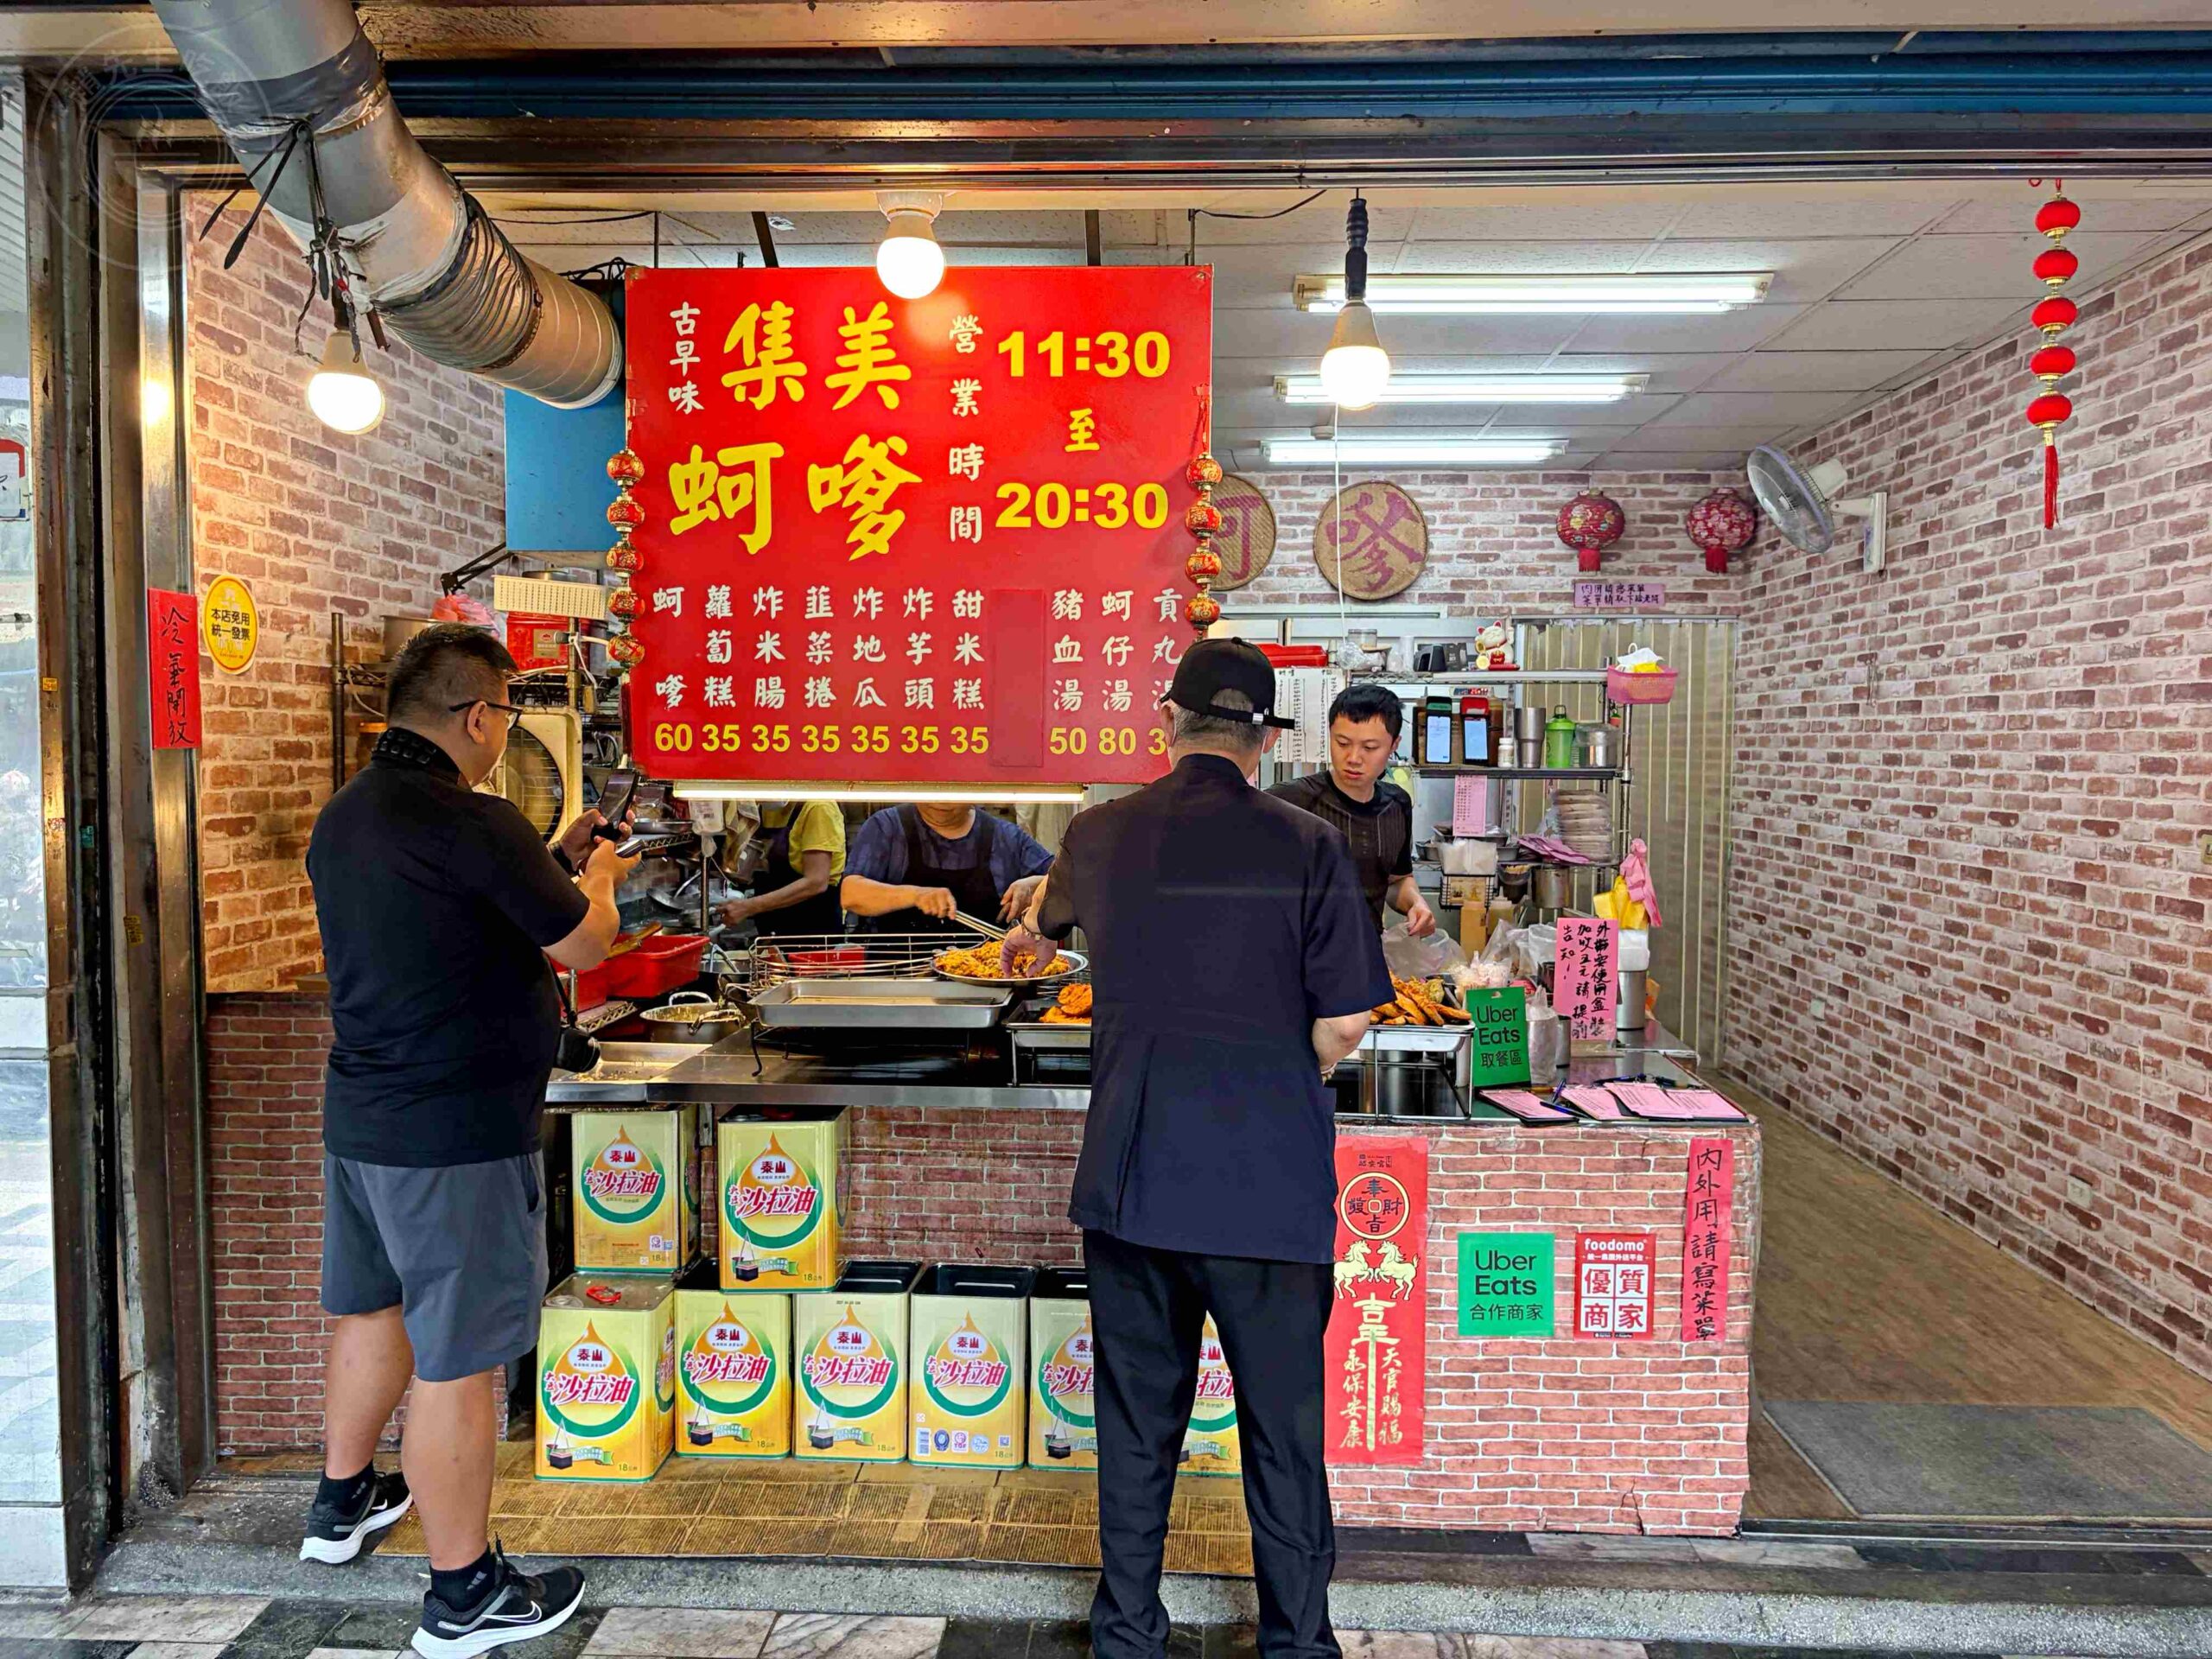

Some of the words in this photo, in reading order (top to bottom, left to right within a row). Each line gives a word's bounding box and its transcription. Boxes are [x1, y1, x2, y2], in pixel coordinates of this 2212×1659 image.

[669, 302, 703, 415] 古早味
[721, 300, 912, 410] 集美
[998, 331, 1171, 378] 11:30
[948, 315, 985, 543] 營業時間
[1065, 409, 1100, 453] 至
[669, 435, 922, 560] 蚵嗲
[995, 482, 1169, 529] 20:30
[211, 607, 251, 626] 本店免用
[211, 623, 251, 641] 統一發票
[703, 584, 736, 708] 蘿蔔糕
[753, 586, 786, 709] 炸米腸
[853, 587, 887, 709] 炸地瓜
[903, 587, 935, 709] 炸芋頭
[952, 588, 985, 710] 甜米糕
[1052, 588, 1084, 712] 豬血湯
[1102, 590, 1135, 713] 蚵仔湯
[160, 607, 195, 747] 冷氣開放
[655, 724, 692, 752] 60
[702, 724, 741, 752] 35
[752, 724, 791, 753] 35
[802, 725, 840, 753] 35
[851, 725, 890, 753] 35
[901, 726, 939, 753] 35
[950, 726, 989, 754] 35
[1050, 727, 1087, 755] 50
[1098, 727, 1136, 755] 80
[1477, 1005, 1518, 1023] Uber
[1478, 1027, 1521, 1046] Eats
[1481, 1050, 1522, 1068] 取餐區
[609, 1150, 636, 1163] 泰山
[760, 1160, 786, 1173] 泰山
[591, 1171, 660, 1195] 沙拉油
[736, 1186, 816, 1215] 沙拉油
[1584, 1237, 1645, 1252] foodomo
[1475, 1249, 1537, 1271] Uber
[1475, 1274, 1537, 1296] Eats
[1584, 1268, 1645, 1294] 優質
[1470, 1303, 1543, 1321] 合作商家
[1584, 1302, 1644, 1329] 商家
[715, 1328, 741, 1341] 泰山
[836, 1332, 862, 1344] 泰山
[957, 1336, 979, 1349] 泰山
[576, 1348, 603, 1362] 泰山
[692, 1353, 770, 1381] 沙拉油
[813, 1357, 893, 1386] 沙拉油
[935, 1360, 1007, 1386] 沙拉油
[552, 1375, 634, 1403] 沙拉油
[1339, 1347, 1368, 1451] 永保安康
[1378, 1347, 1403, 1446] 天官賜福
